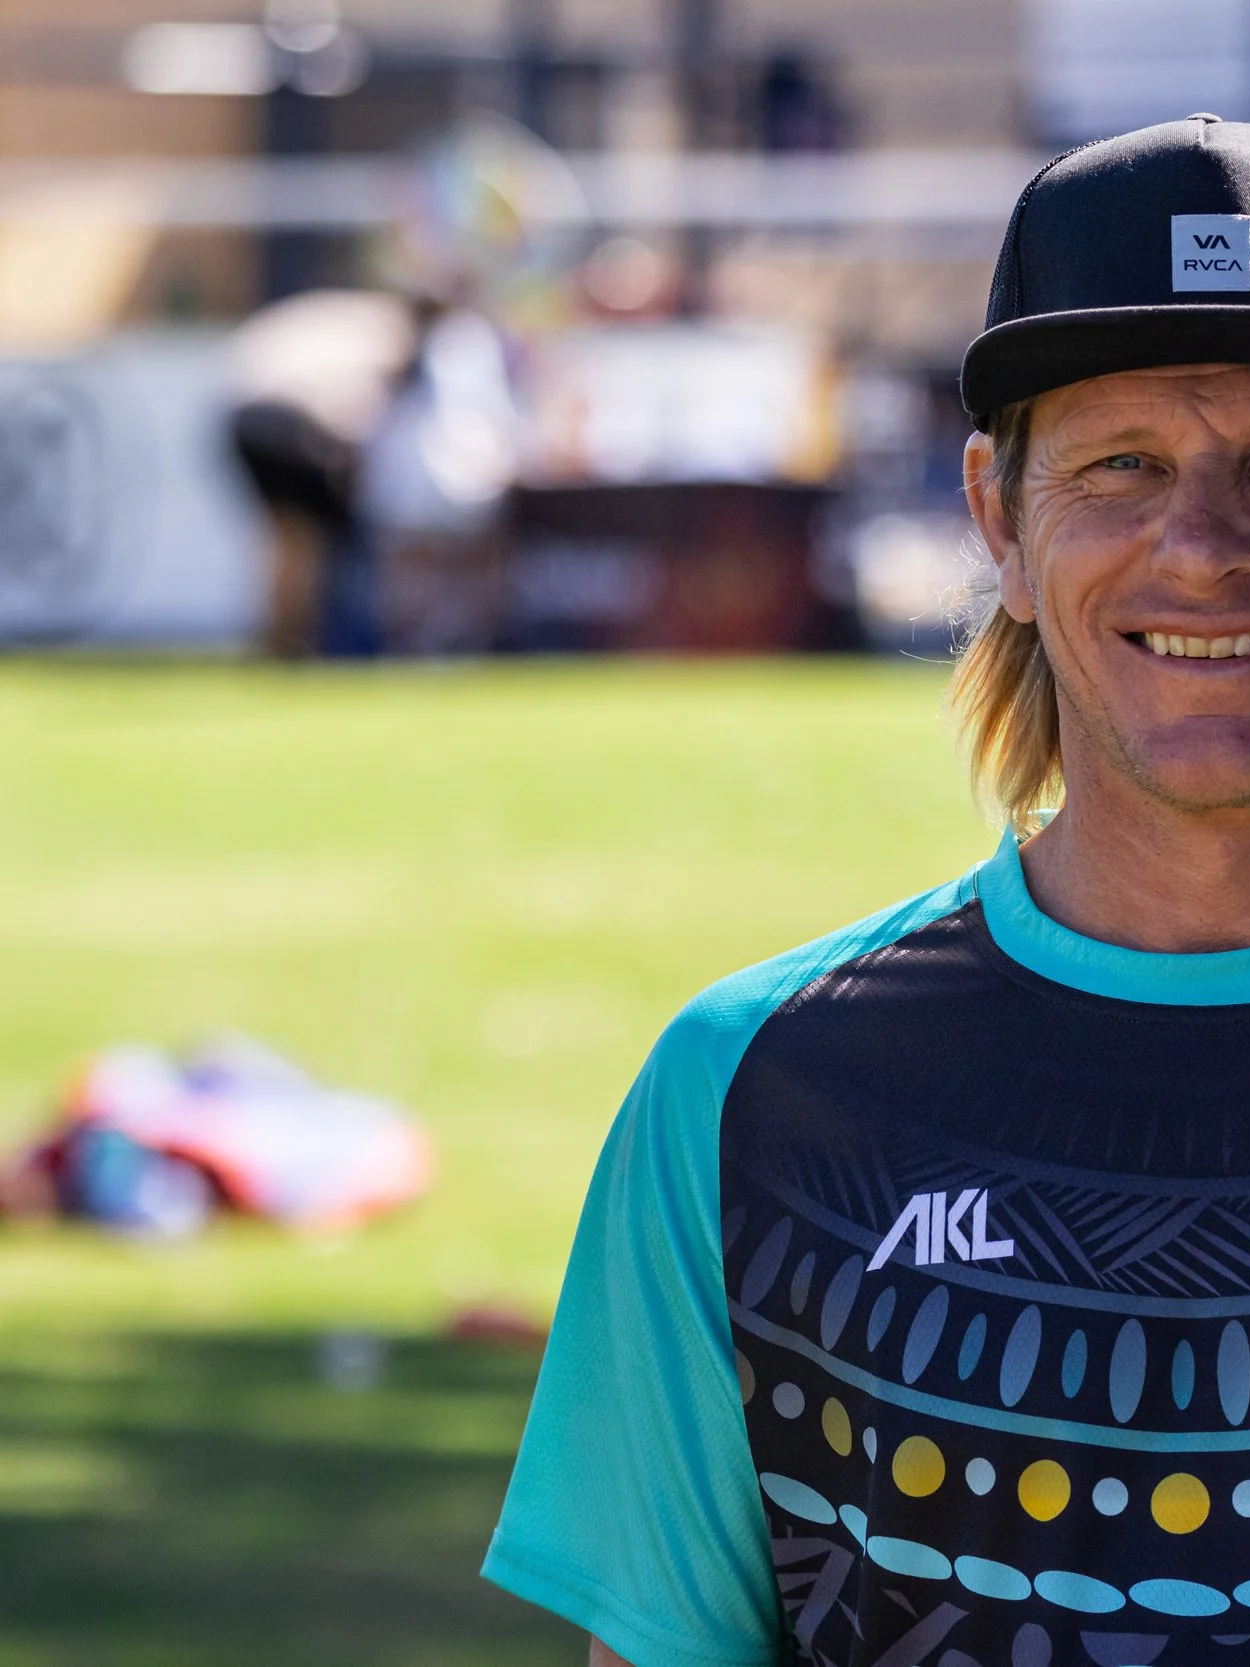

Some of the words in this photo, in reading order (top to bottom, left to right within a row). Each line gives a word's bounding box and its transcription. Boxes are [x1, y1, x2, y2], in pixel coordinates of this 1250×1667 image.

[1193, 235, 1231, 249] VA
[1184, 259, 1243, 272] RVCA
[866, 1188, 1014, 1272] AKL
